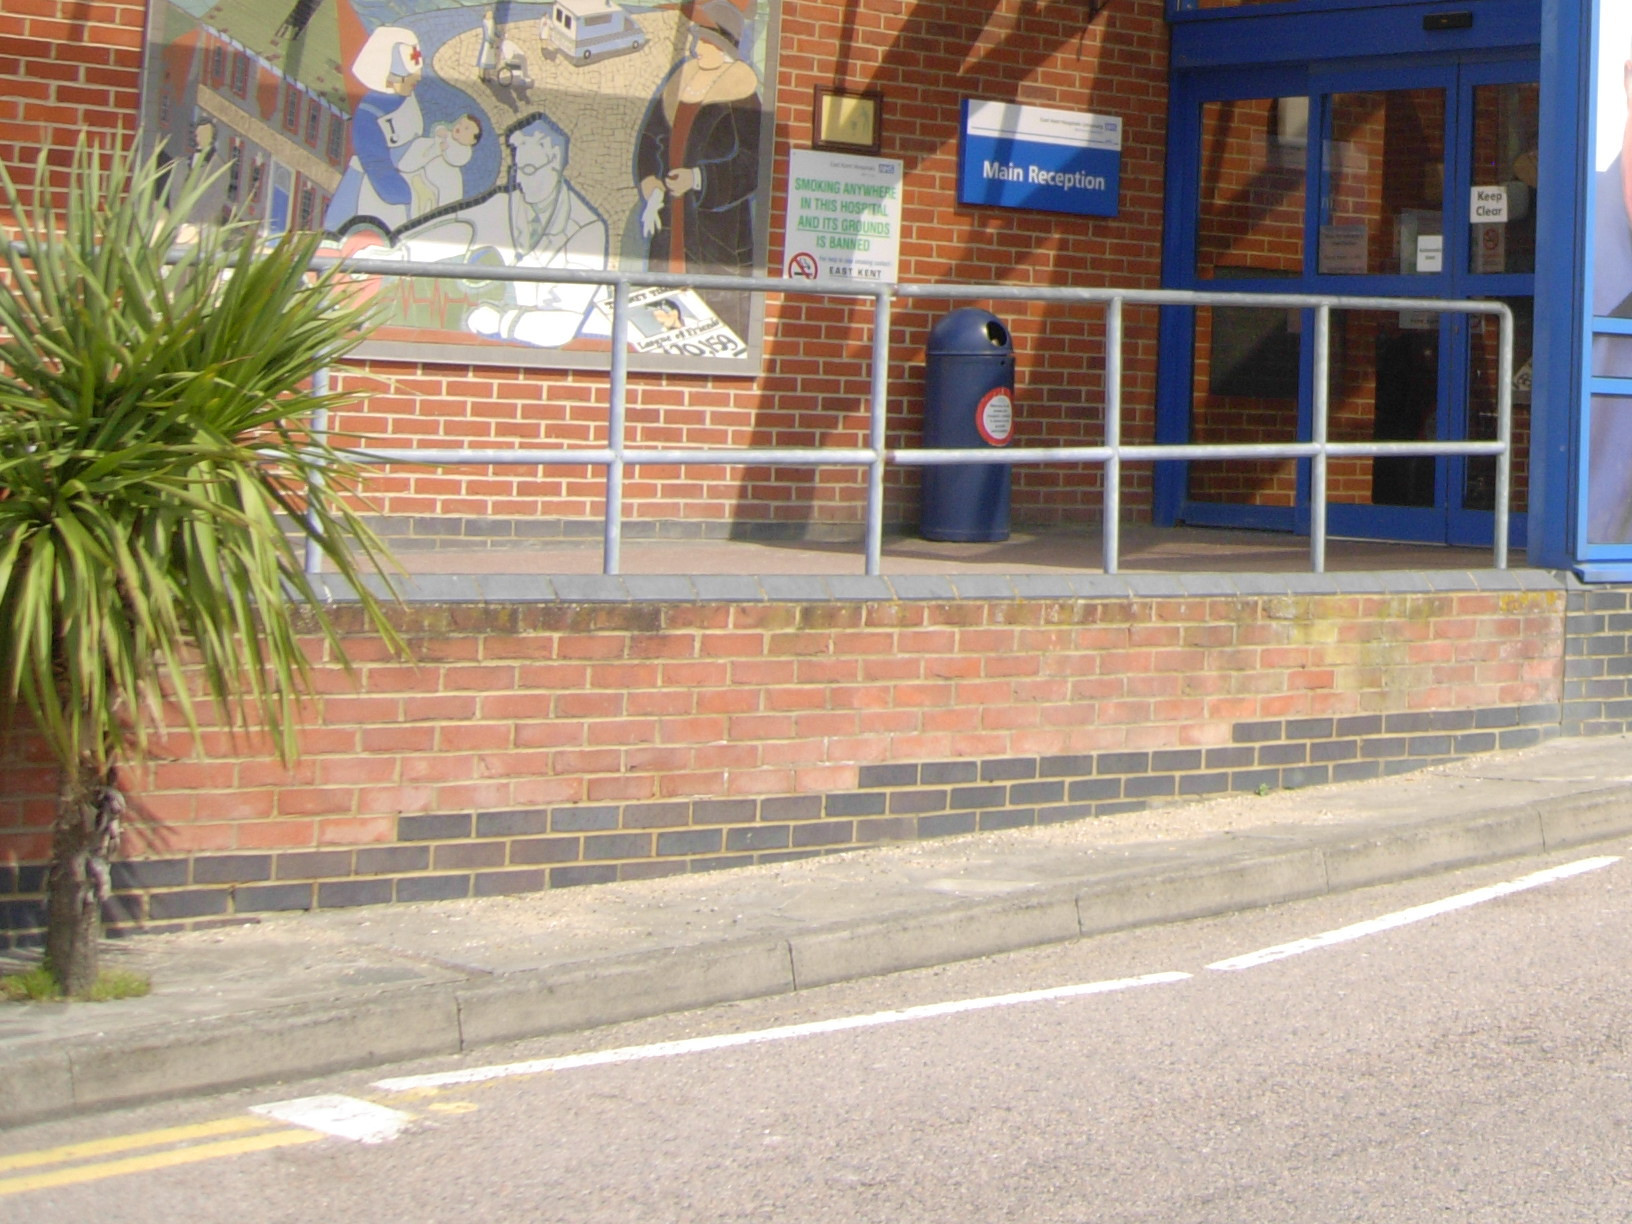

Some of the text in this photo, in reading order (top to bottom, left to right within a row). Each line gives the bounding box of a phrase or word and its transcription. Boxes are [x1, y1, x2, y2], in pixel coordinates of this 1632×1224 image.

[983, 160, 1105, 191] Main Reception
[795, 177, 896, 200] SMOKING ANYWHERE
[1477, 190, 1503, 203] Keep
[800, 196, 888, 217] IN THIS HOSPITAL
[1476, 206, 1503, 217] Clear
[798, 215, 890, 235] AND ITS GROUNDS
[816, 235, 870, 251] IS BANNED
[829, 266, 882, 277] EAST KENT
[638, 317, 720, 349] League of Friends
